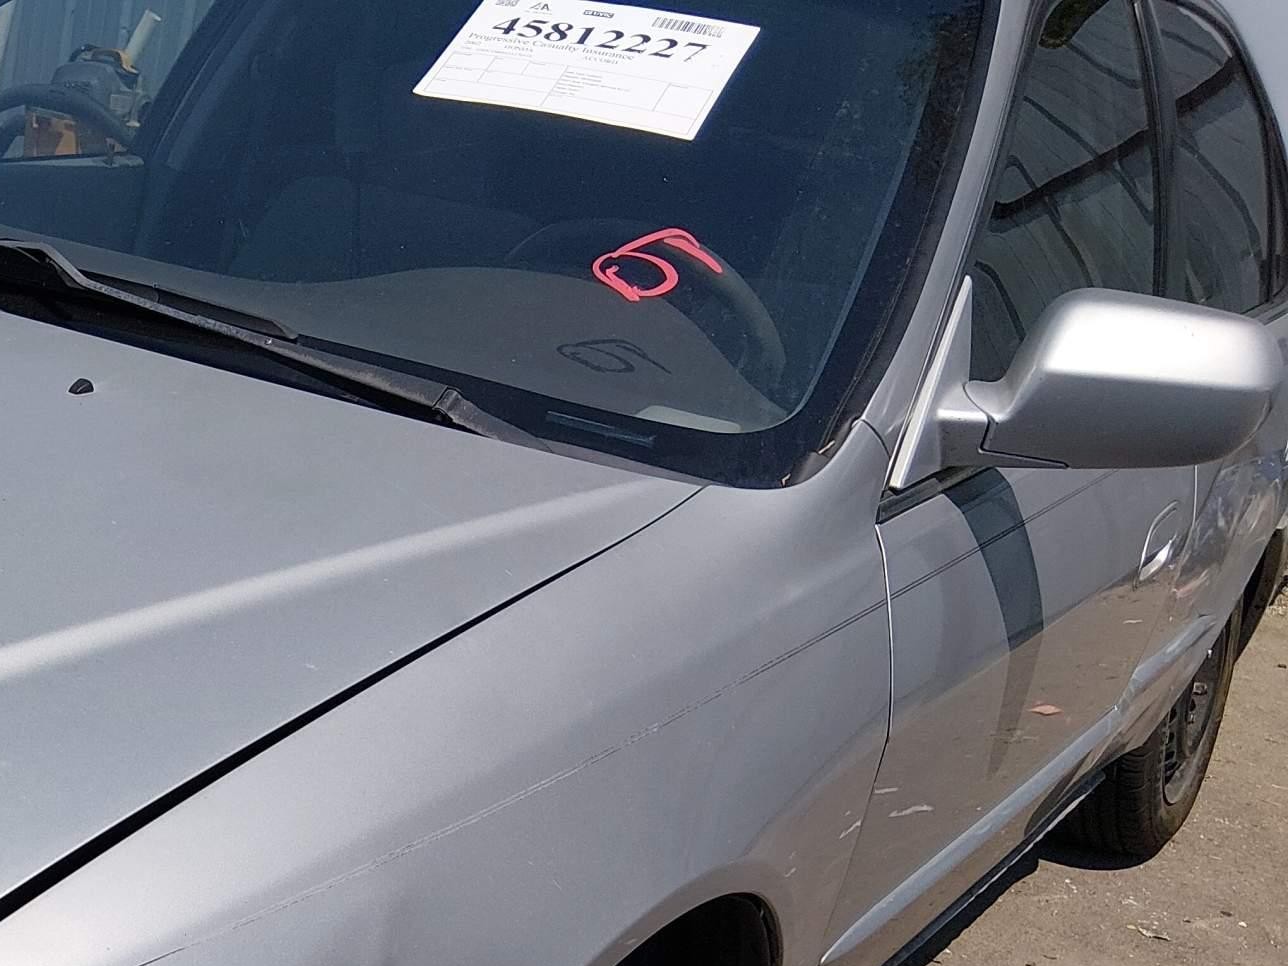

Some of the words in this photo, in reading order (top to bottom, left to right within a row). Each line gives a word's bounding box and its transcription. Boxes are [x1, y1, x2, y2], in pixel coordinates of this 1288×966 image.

[468, 31, 531, 47] Progressive
[532, 40, 580, 54] Casualty
[581, 47, 635, 61] Insurance
[491, 16, 713, 63] 45812227
